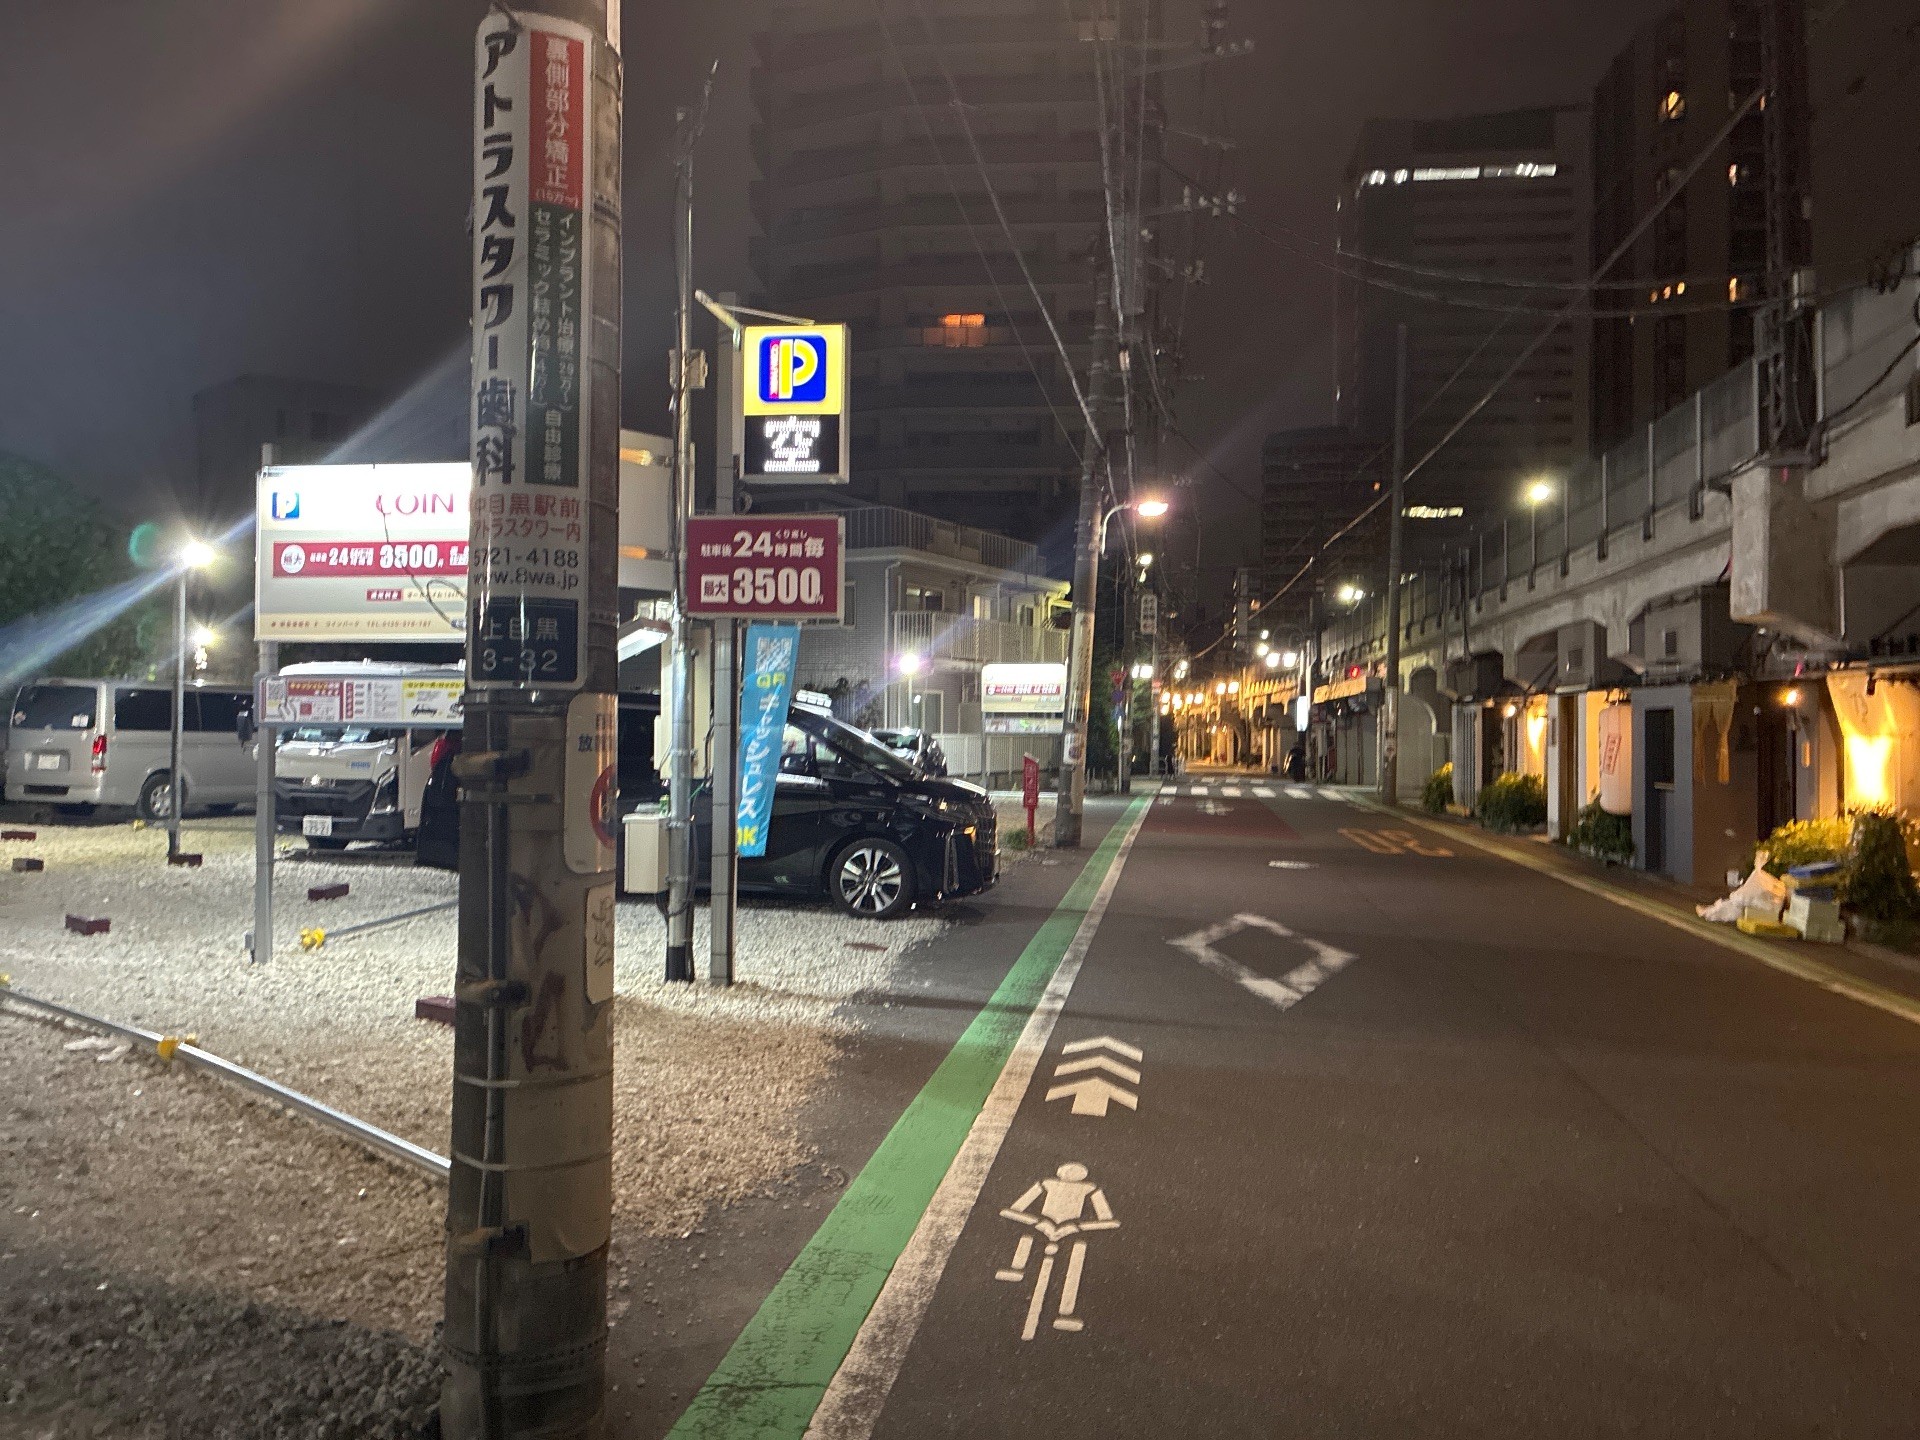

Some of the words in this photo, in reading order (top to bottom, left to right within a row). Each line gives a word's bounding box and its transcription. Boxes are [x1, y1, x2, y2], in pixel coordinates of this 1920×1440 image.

[478, 30, 518, 486] アトラスタワー歯科
[763, 416, 821, 472] 空
[474, 492, 580, 519] 中目黒駅前
[474, 517, 581, 543] アトラスタワー内
[473, 547, 579, 569] 5721-4188
[473, 567, 579, 591] www.8wa.jp
[703, 579, 727, 597] 最大
[482, 616, 560, 642] 上目黒
[482, 648, 559, 672] 3-32
